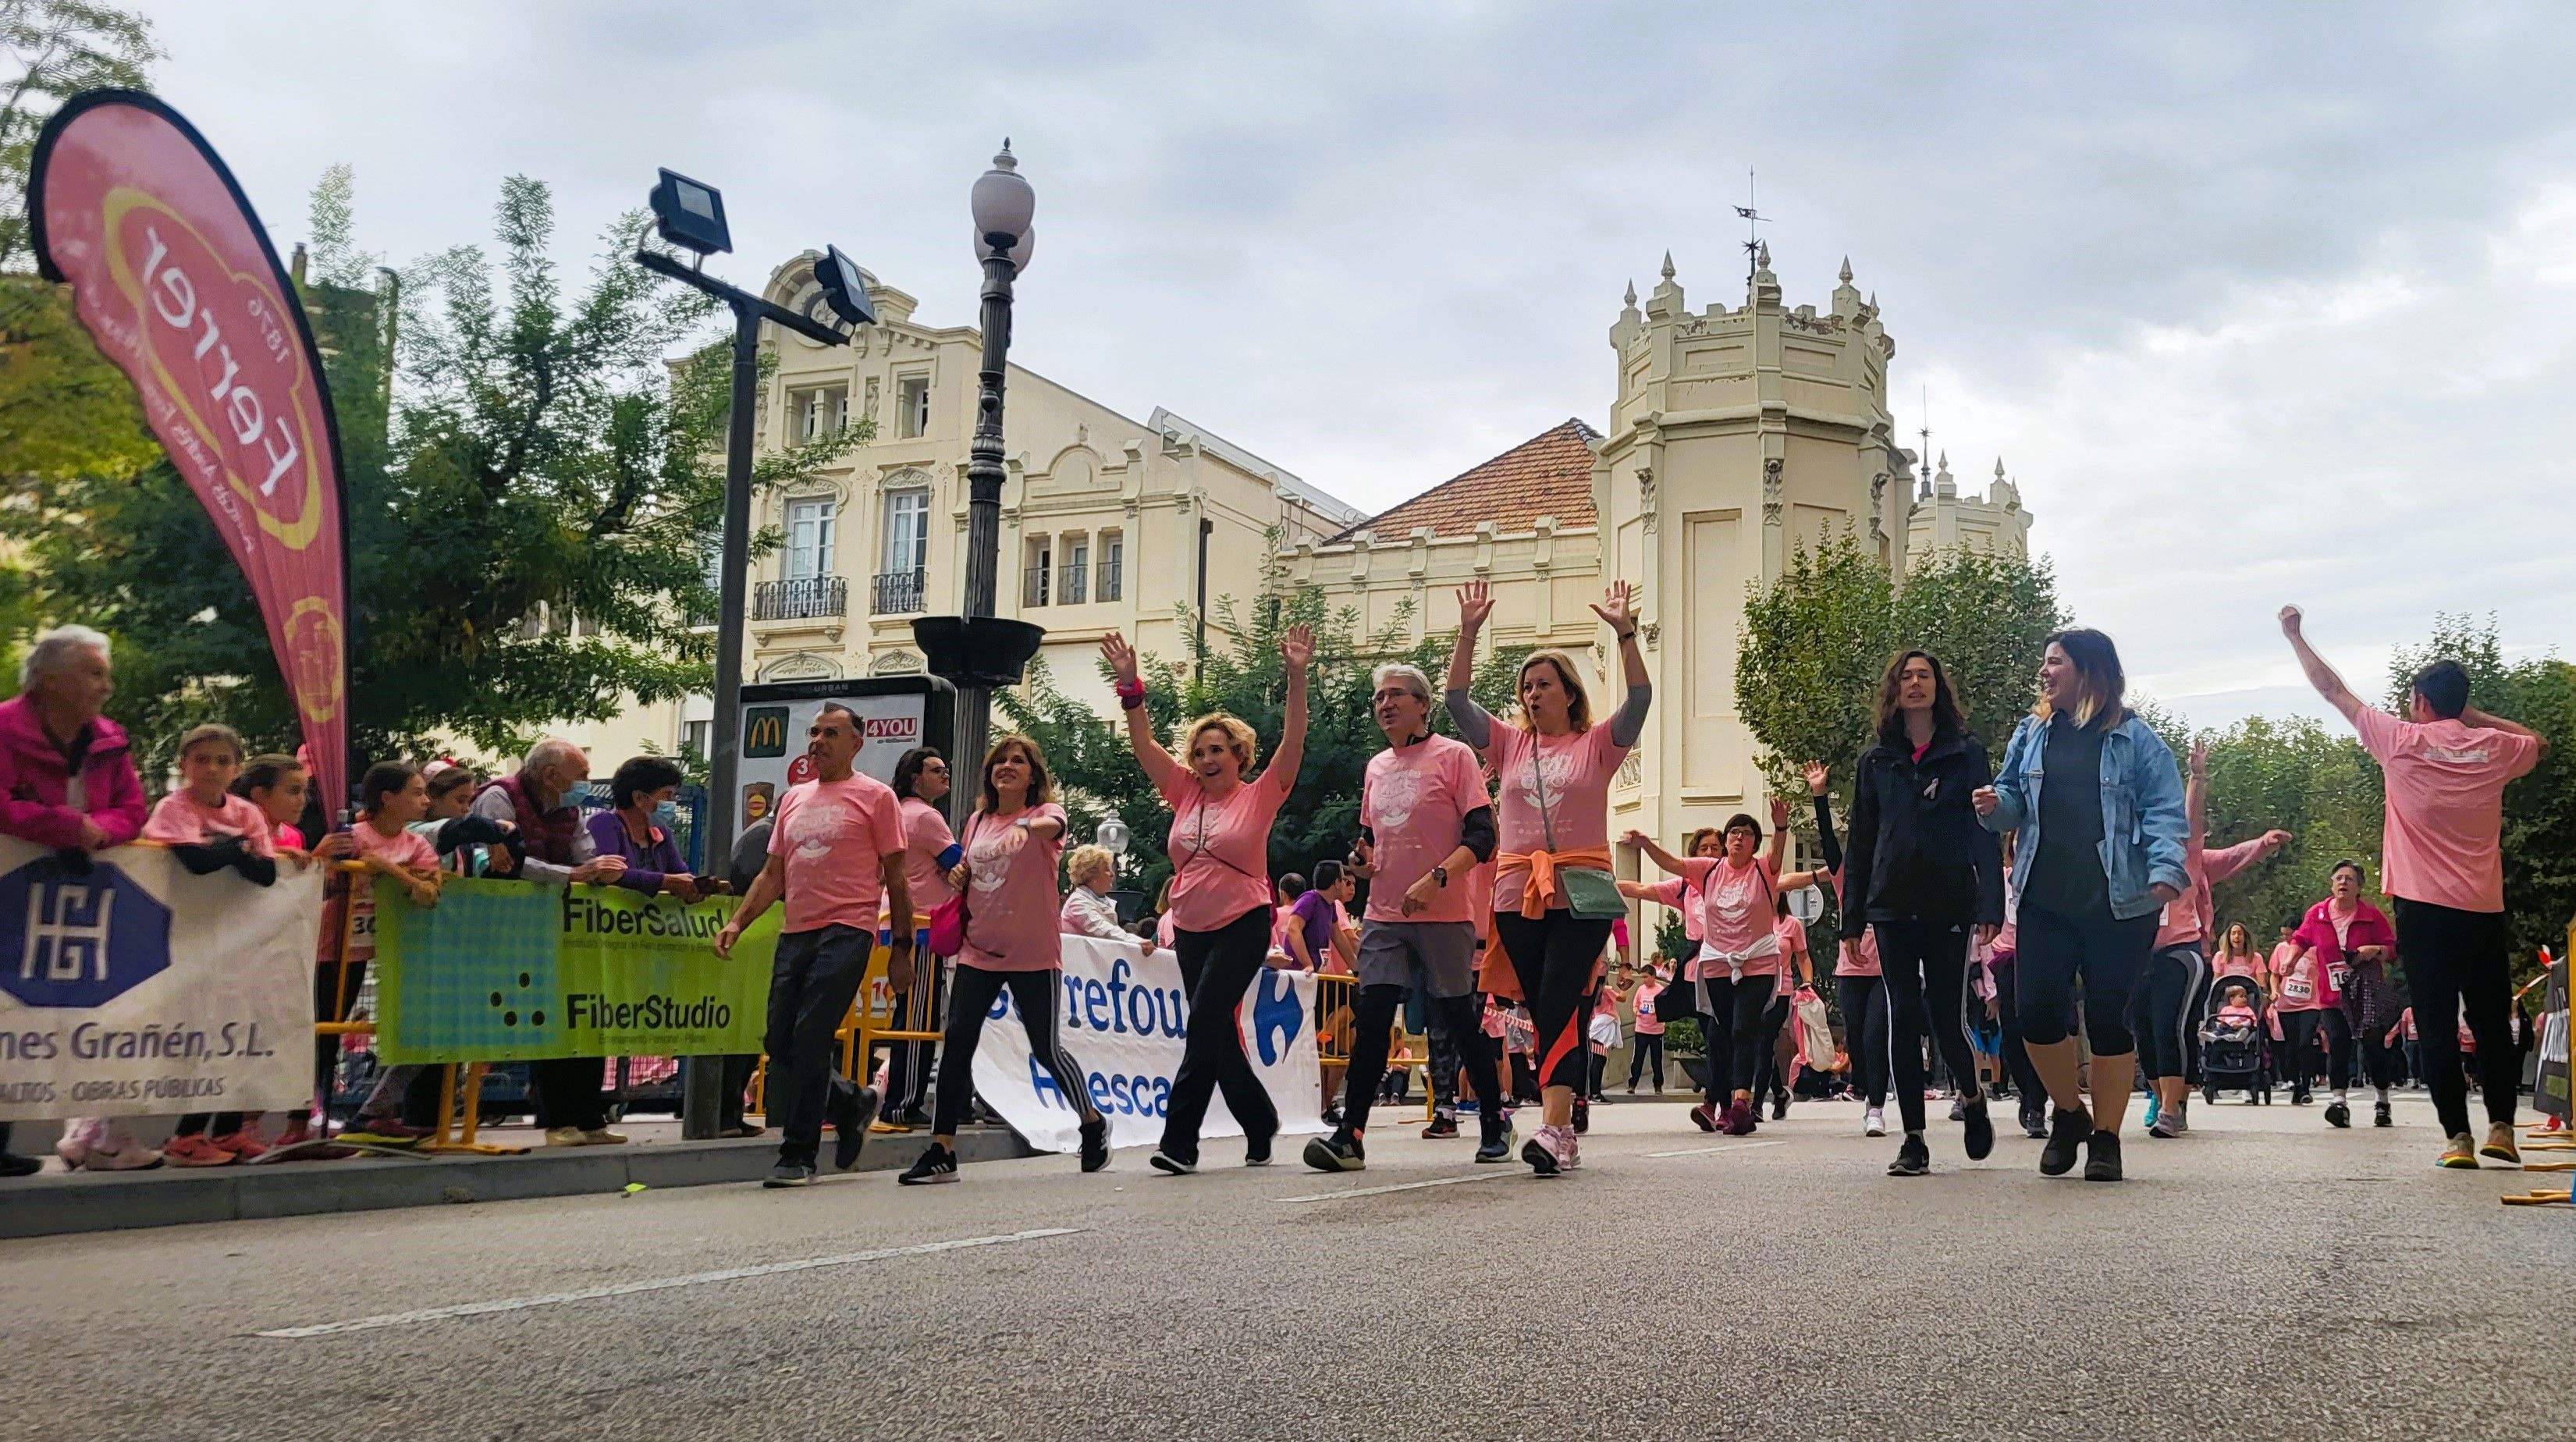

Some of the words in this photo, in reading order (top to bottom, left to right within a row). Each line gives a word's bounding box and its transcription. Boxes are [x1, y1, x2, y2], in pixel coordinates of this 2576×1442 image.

[813, 682, 849, 693] URBAN
[867, 718, 917, 737] 4YOU
[796, 758, 808, 775] 3
[563, 897, 724, 939] FiberSalud
[567, 993, 731, 1030] FiberStudio
[70, 1021, 211, 1062] Grañén,
[1028, 1052, 1171, 1117] Hesca
